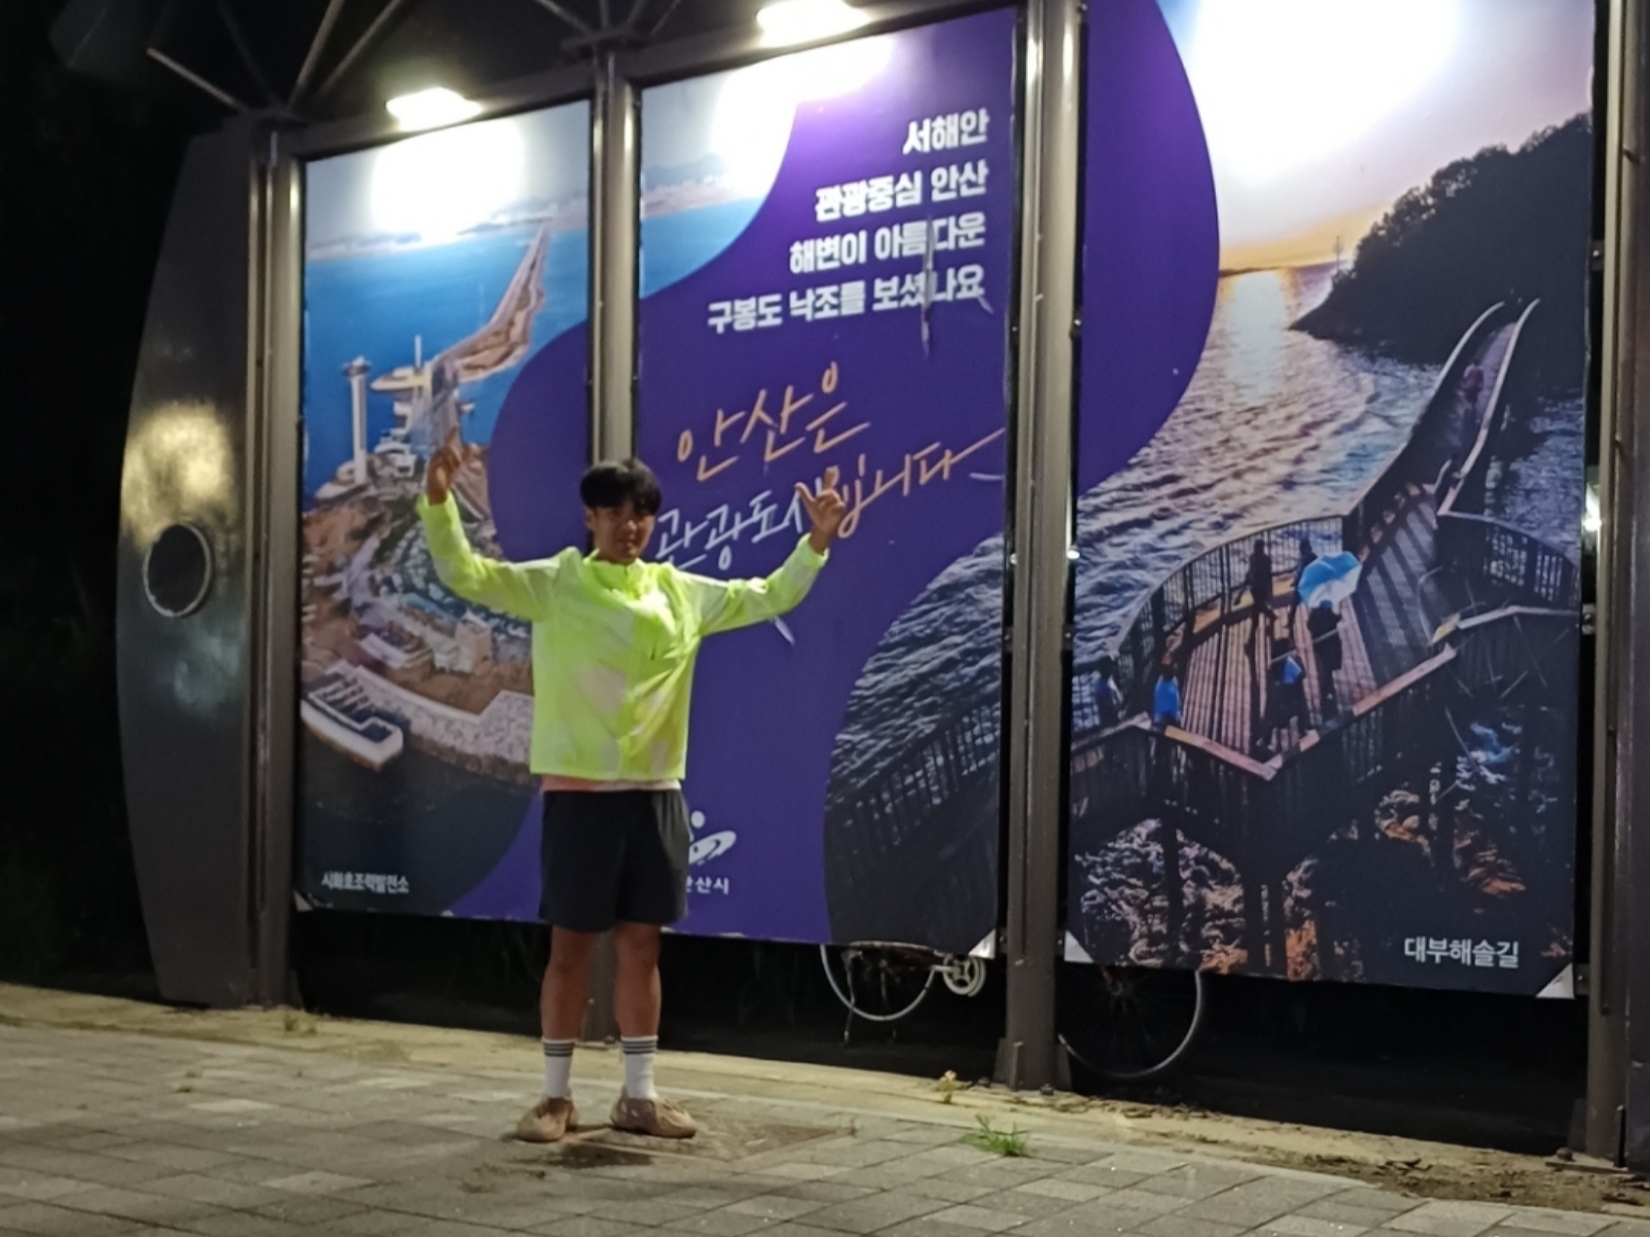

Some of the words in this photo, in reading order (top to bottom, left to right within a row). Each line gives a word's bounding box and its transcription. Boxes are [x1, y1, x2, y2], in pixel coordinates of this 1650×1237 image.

[902, 107, 990, 155] 서해안
[815, 170, 923, 222] 관광중심
[931, 158, 989, 202] 안산
[789, 229, 867, 274] 해변이
[874, 211, 986, 260] 아름다운
[707, 293, 783, 334] 구봉도
[790, 280, 866, 322] 낙조를
[872, 263, 985, 311] 보셨나요
[677, 361, 871, 482] 안산은
[1404, 935, 1519, 969] 대부해솔길
